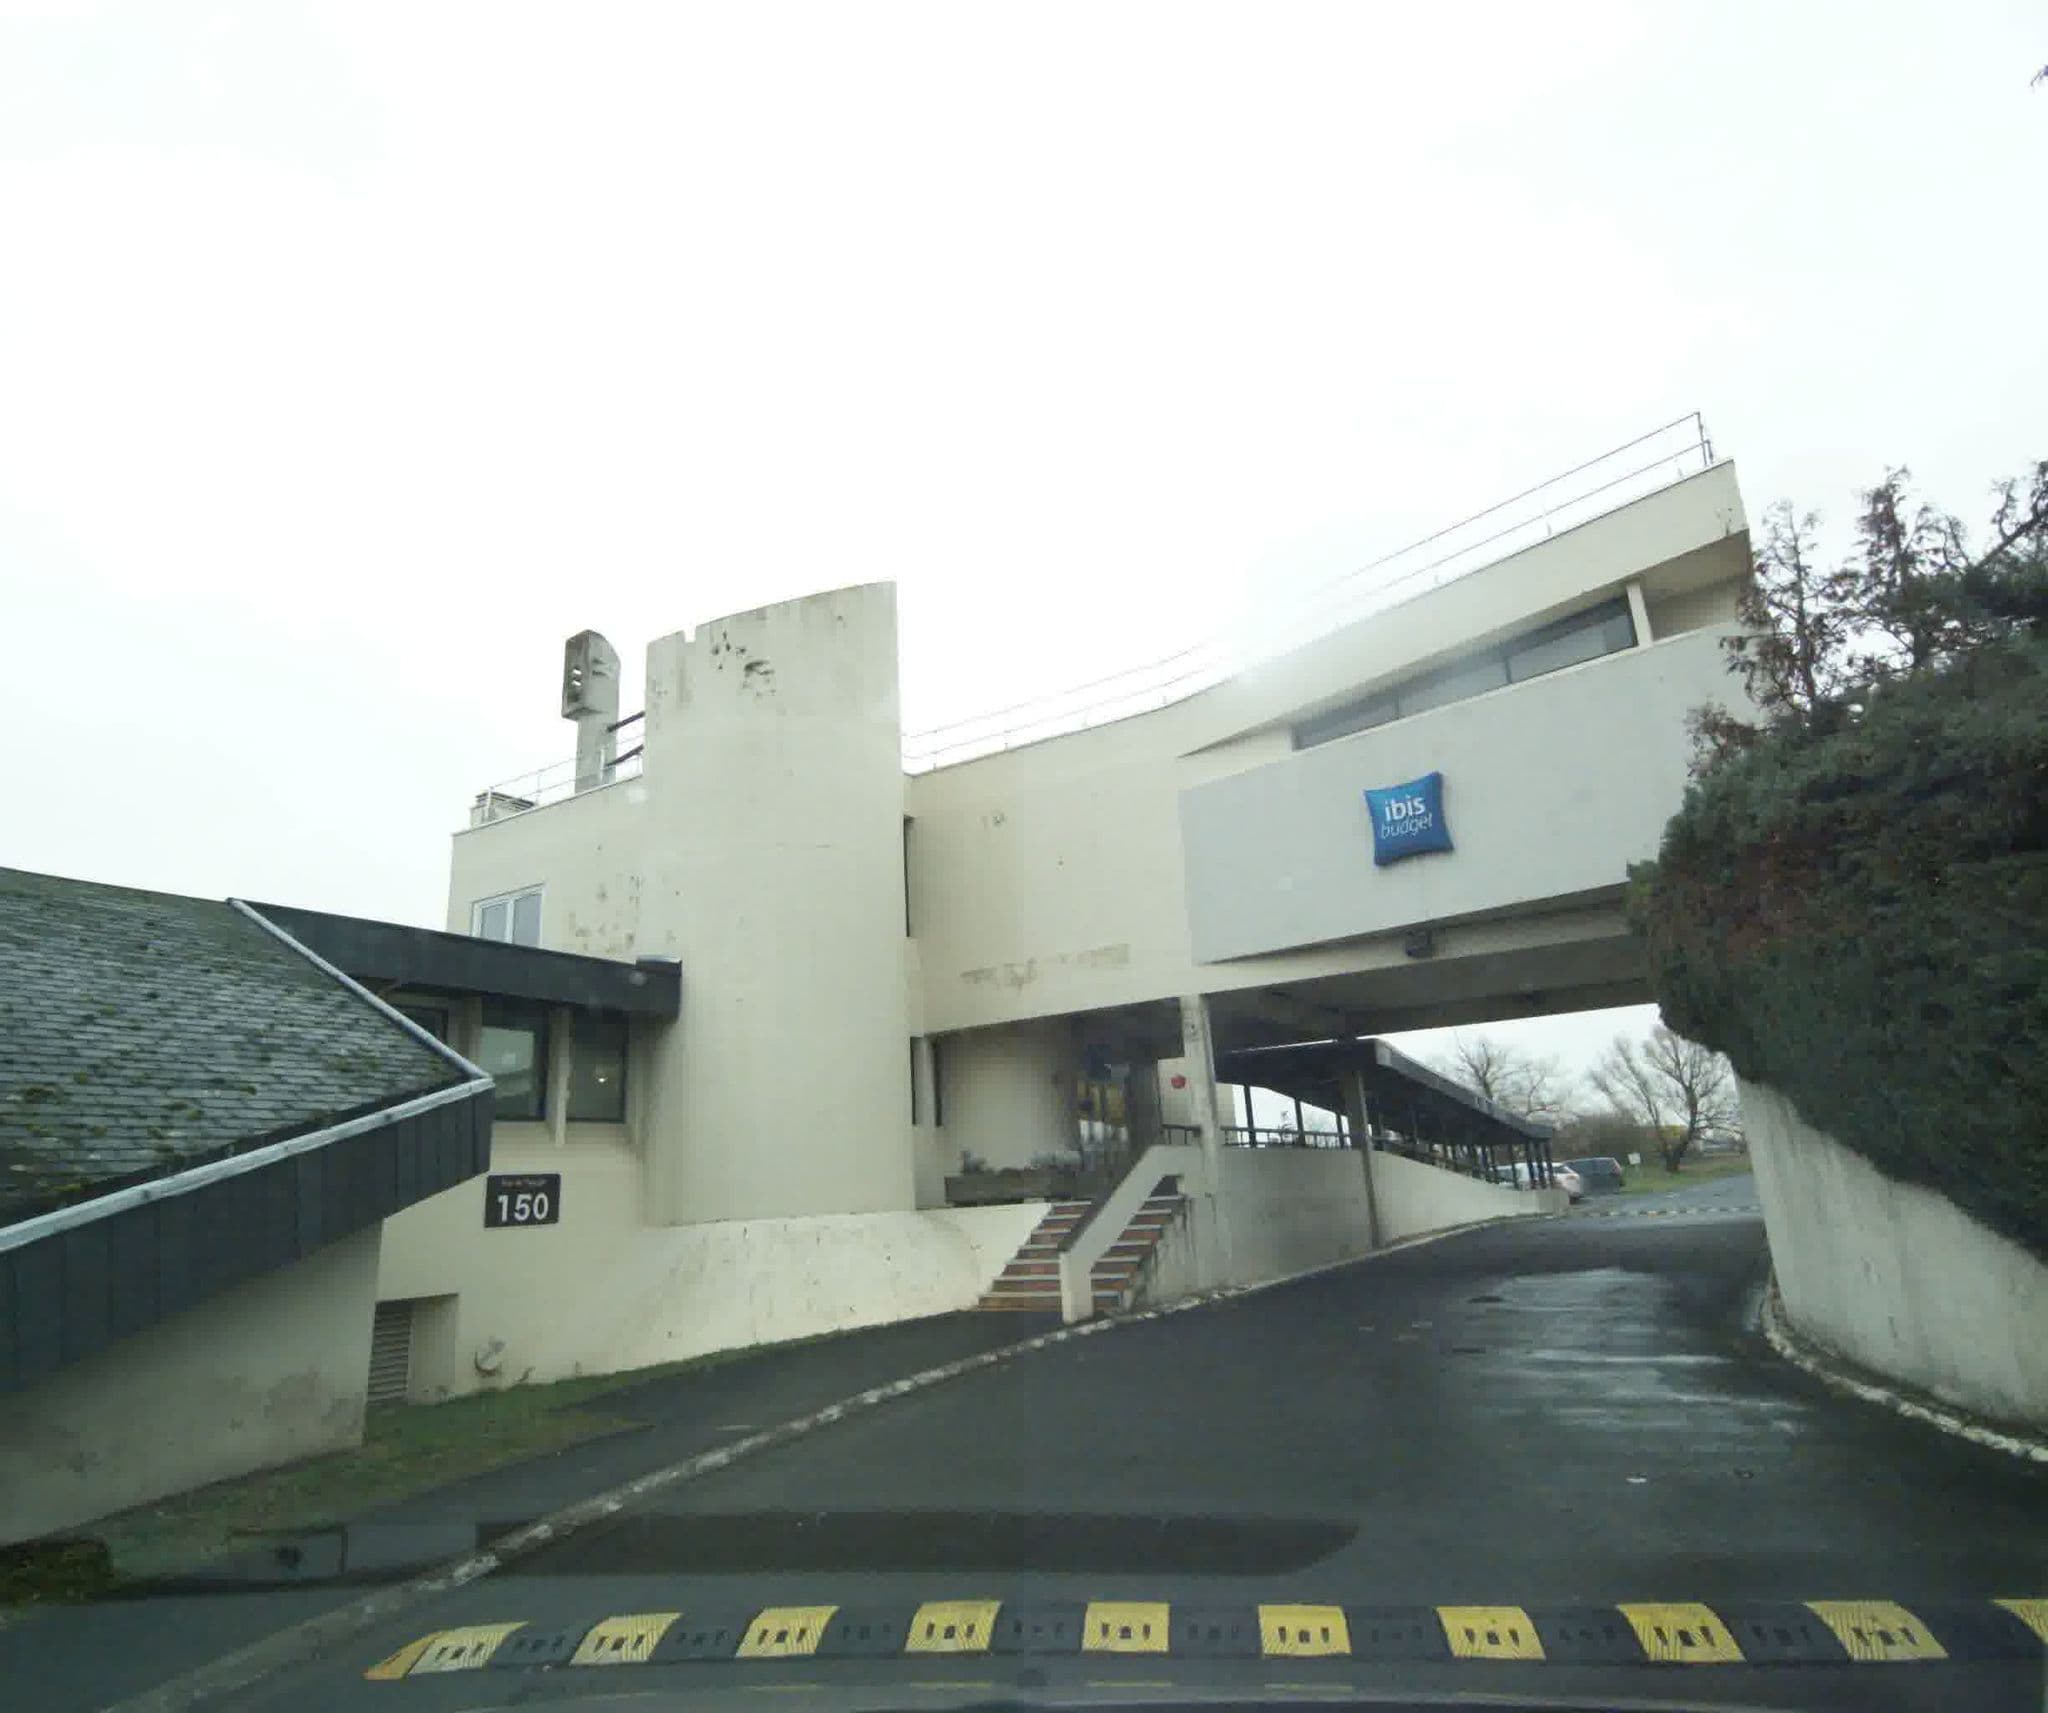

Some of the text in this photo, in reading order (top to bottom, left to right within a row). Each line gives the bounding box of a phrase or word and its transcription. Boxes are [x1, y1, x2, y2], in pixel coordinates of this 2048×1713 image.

[1384, 794, 1425, 821] ibis
[1381, 813, 1432, 839] budget
[497, 1193, 549, 1222] 150
